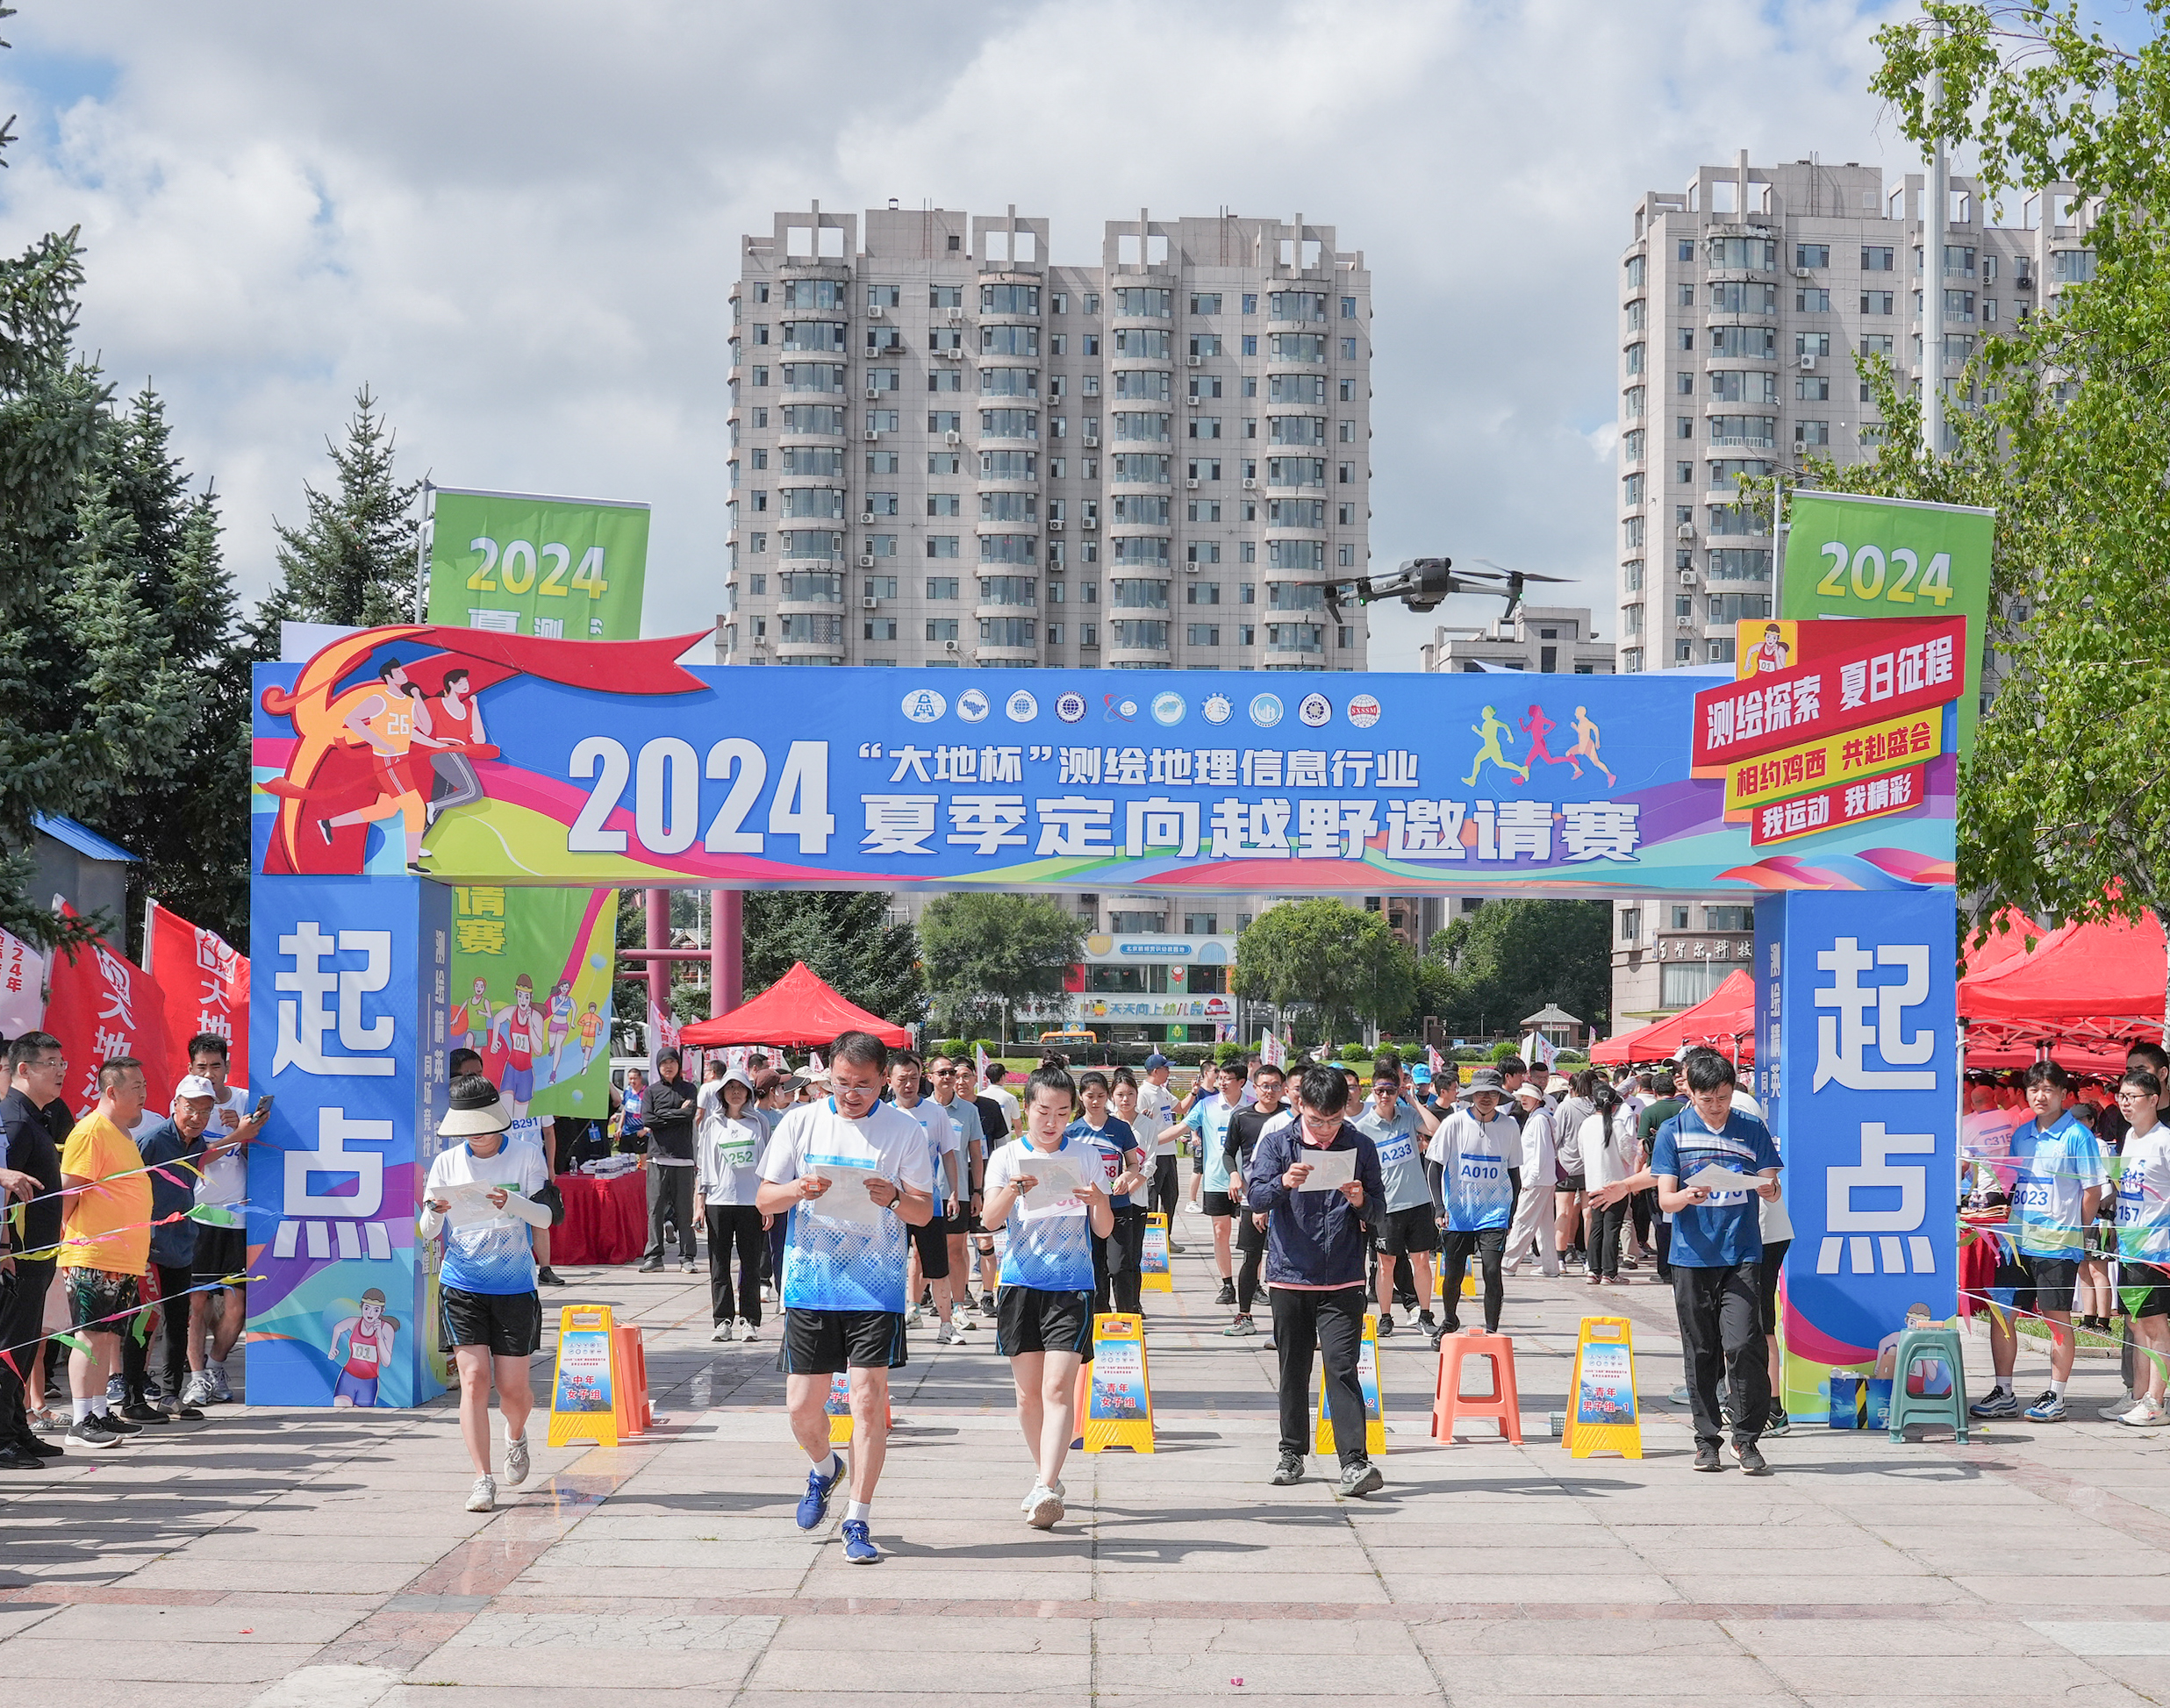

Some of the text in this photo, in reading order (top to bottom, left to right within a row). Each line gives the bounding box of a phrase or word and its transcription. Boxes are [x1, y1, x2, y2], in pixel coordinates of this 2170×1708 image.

[466, 537, 609, 600] 2024
[1815, 540, 1955, 607] 2024
[1706, 634, 1953, 750] 测绘探索 夏日征程
[1351, 705, 1377, 716] SXSSM
[387, 711, 410, 735] 26
[1737, 721, 1932, 797] 相约鸡西 共赴盛会
[568, 736, 835, 856] 2024
[1762, 772, 1912, 839] 我运动 我精彩
[858, 794, 1642, 863] 夏季定向越野邀请赛
[434, 929, 446, 1084] 测绘精英
[1109, 1002, 1204, 1017] 天天向上幼儿园
[1770, 942, 1781, 1098] 测绘精英
[272, 921, 396, 1260] 起点
[1813, 937, 1937, 1274] 起点
[512, 1117, 539, 1130] B291
[724, 1150, 754, 1166] 252
[1381, 1143, 1413, 1163] A233
[1461, 1165, 1499, 1179] A010
[573, 1375, 596, 1385] 中年
[1106, 1383, 1129, 1393] 青年
[567, 1389, 602, 1400] 女子组
[1100, 1397, 1136, 1408] 女子组
[1594, 1387, 1617, 1397] 青年
[1583, 1400, 1629, 1412] 男子组-1
